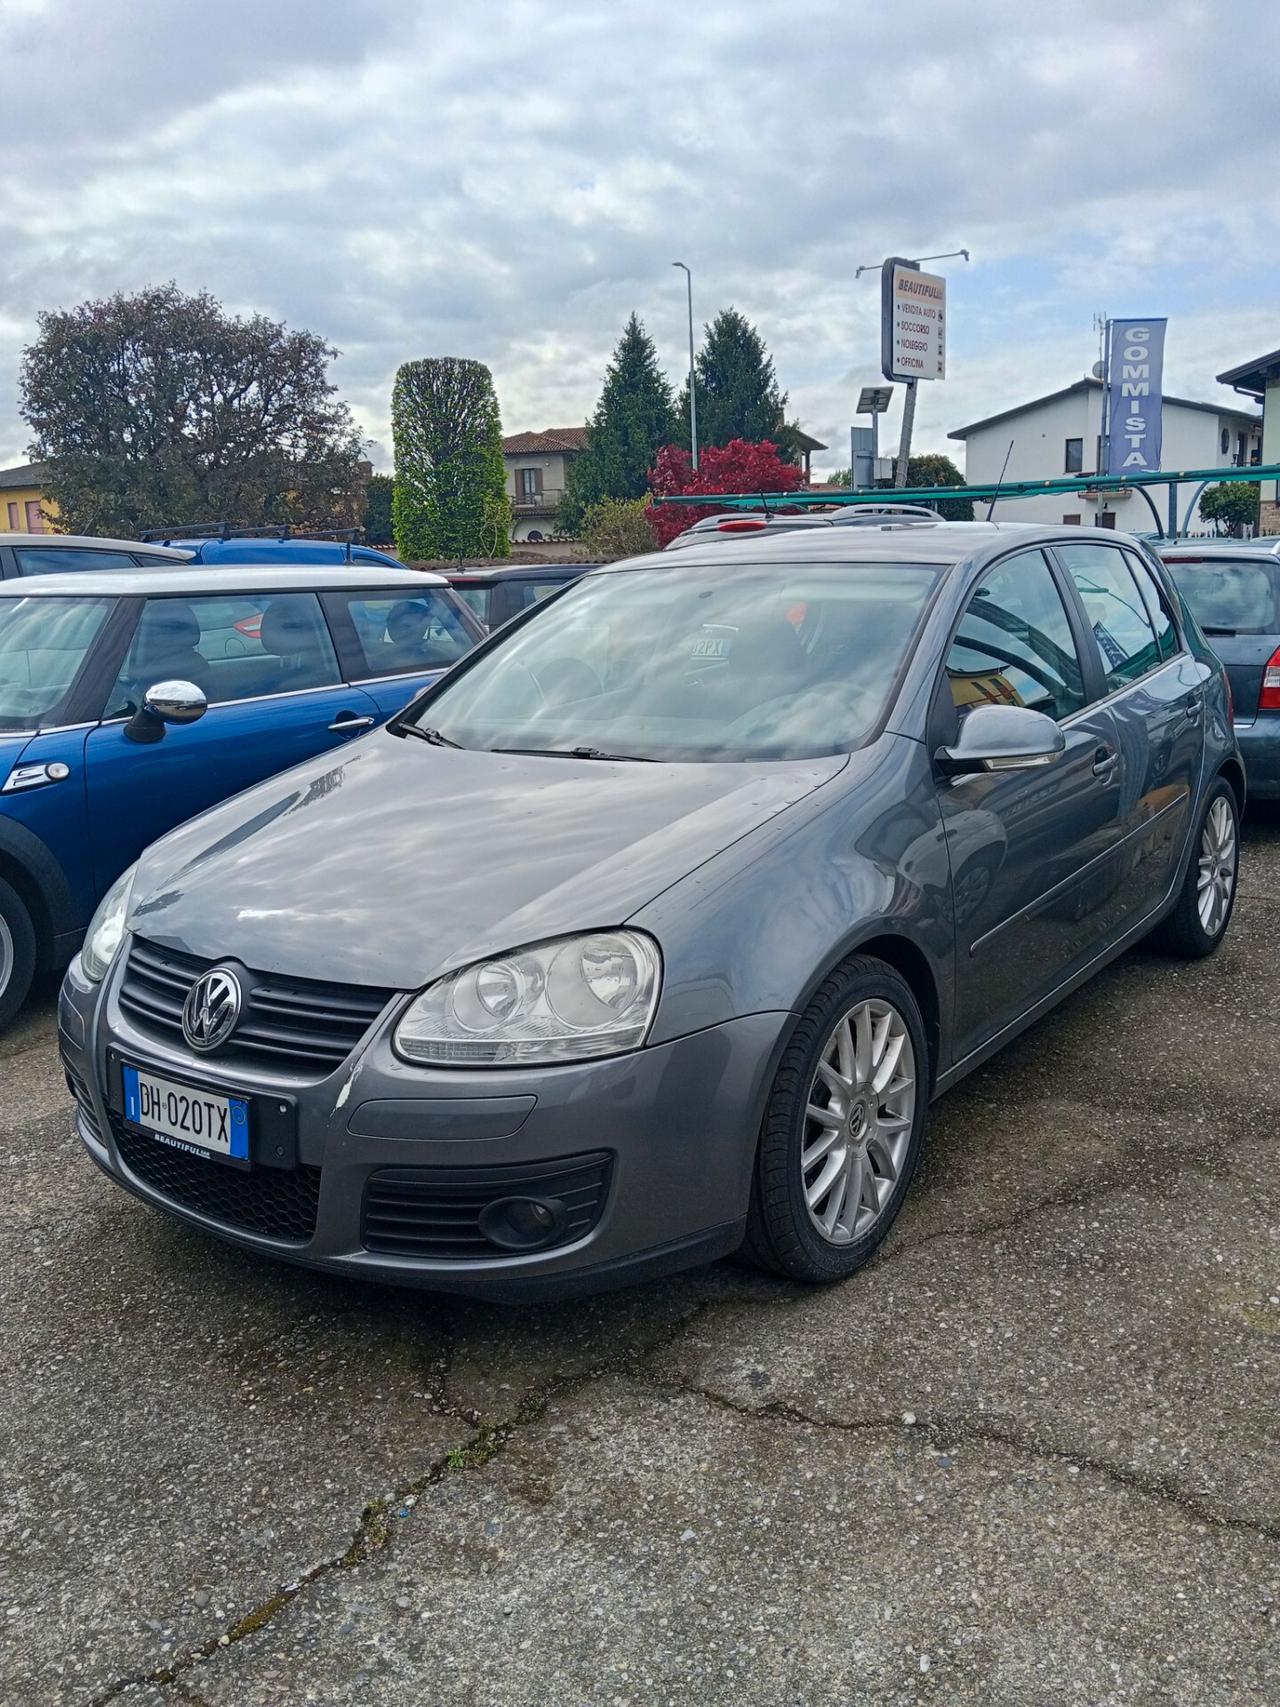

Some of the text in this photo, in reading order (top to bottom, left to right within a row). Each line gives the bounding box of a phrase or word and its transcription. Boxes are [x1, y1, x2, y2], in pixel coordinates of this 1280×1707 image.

[902, 304, 936, 319] VENDITA AUTO
[901, 321, 930, 335] SOCCORSO
[901, 338, 928, 352] NOLEGGIO
[901, 356, 924, 369] OFFICINA
[1122, 327, 1149, 467] GOMMISTA
[154, 1133, 202, 1157] BEAUTIFUL
